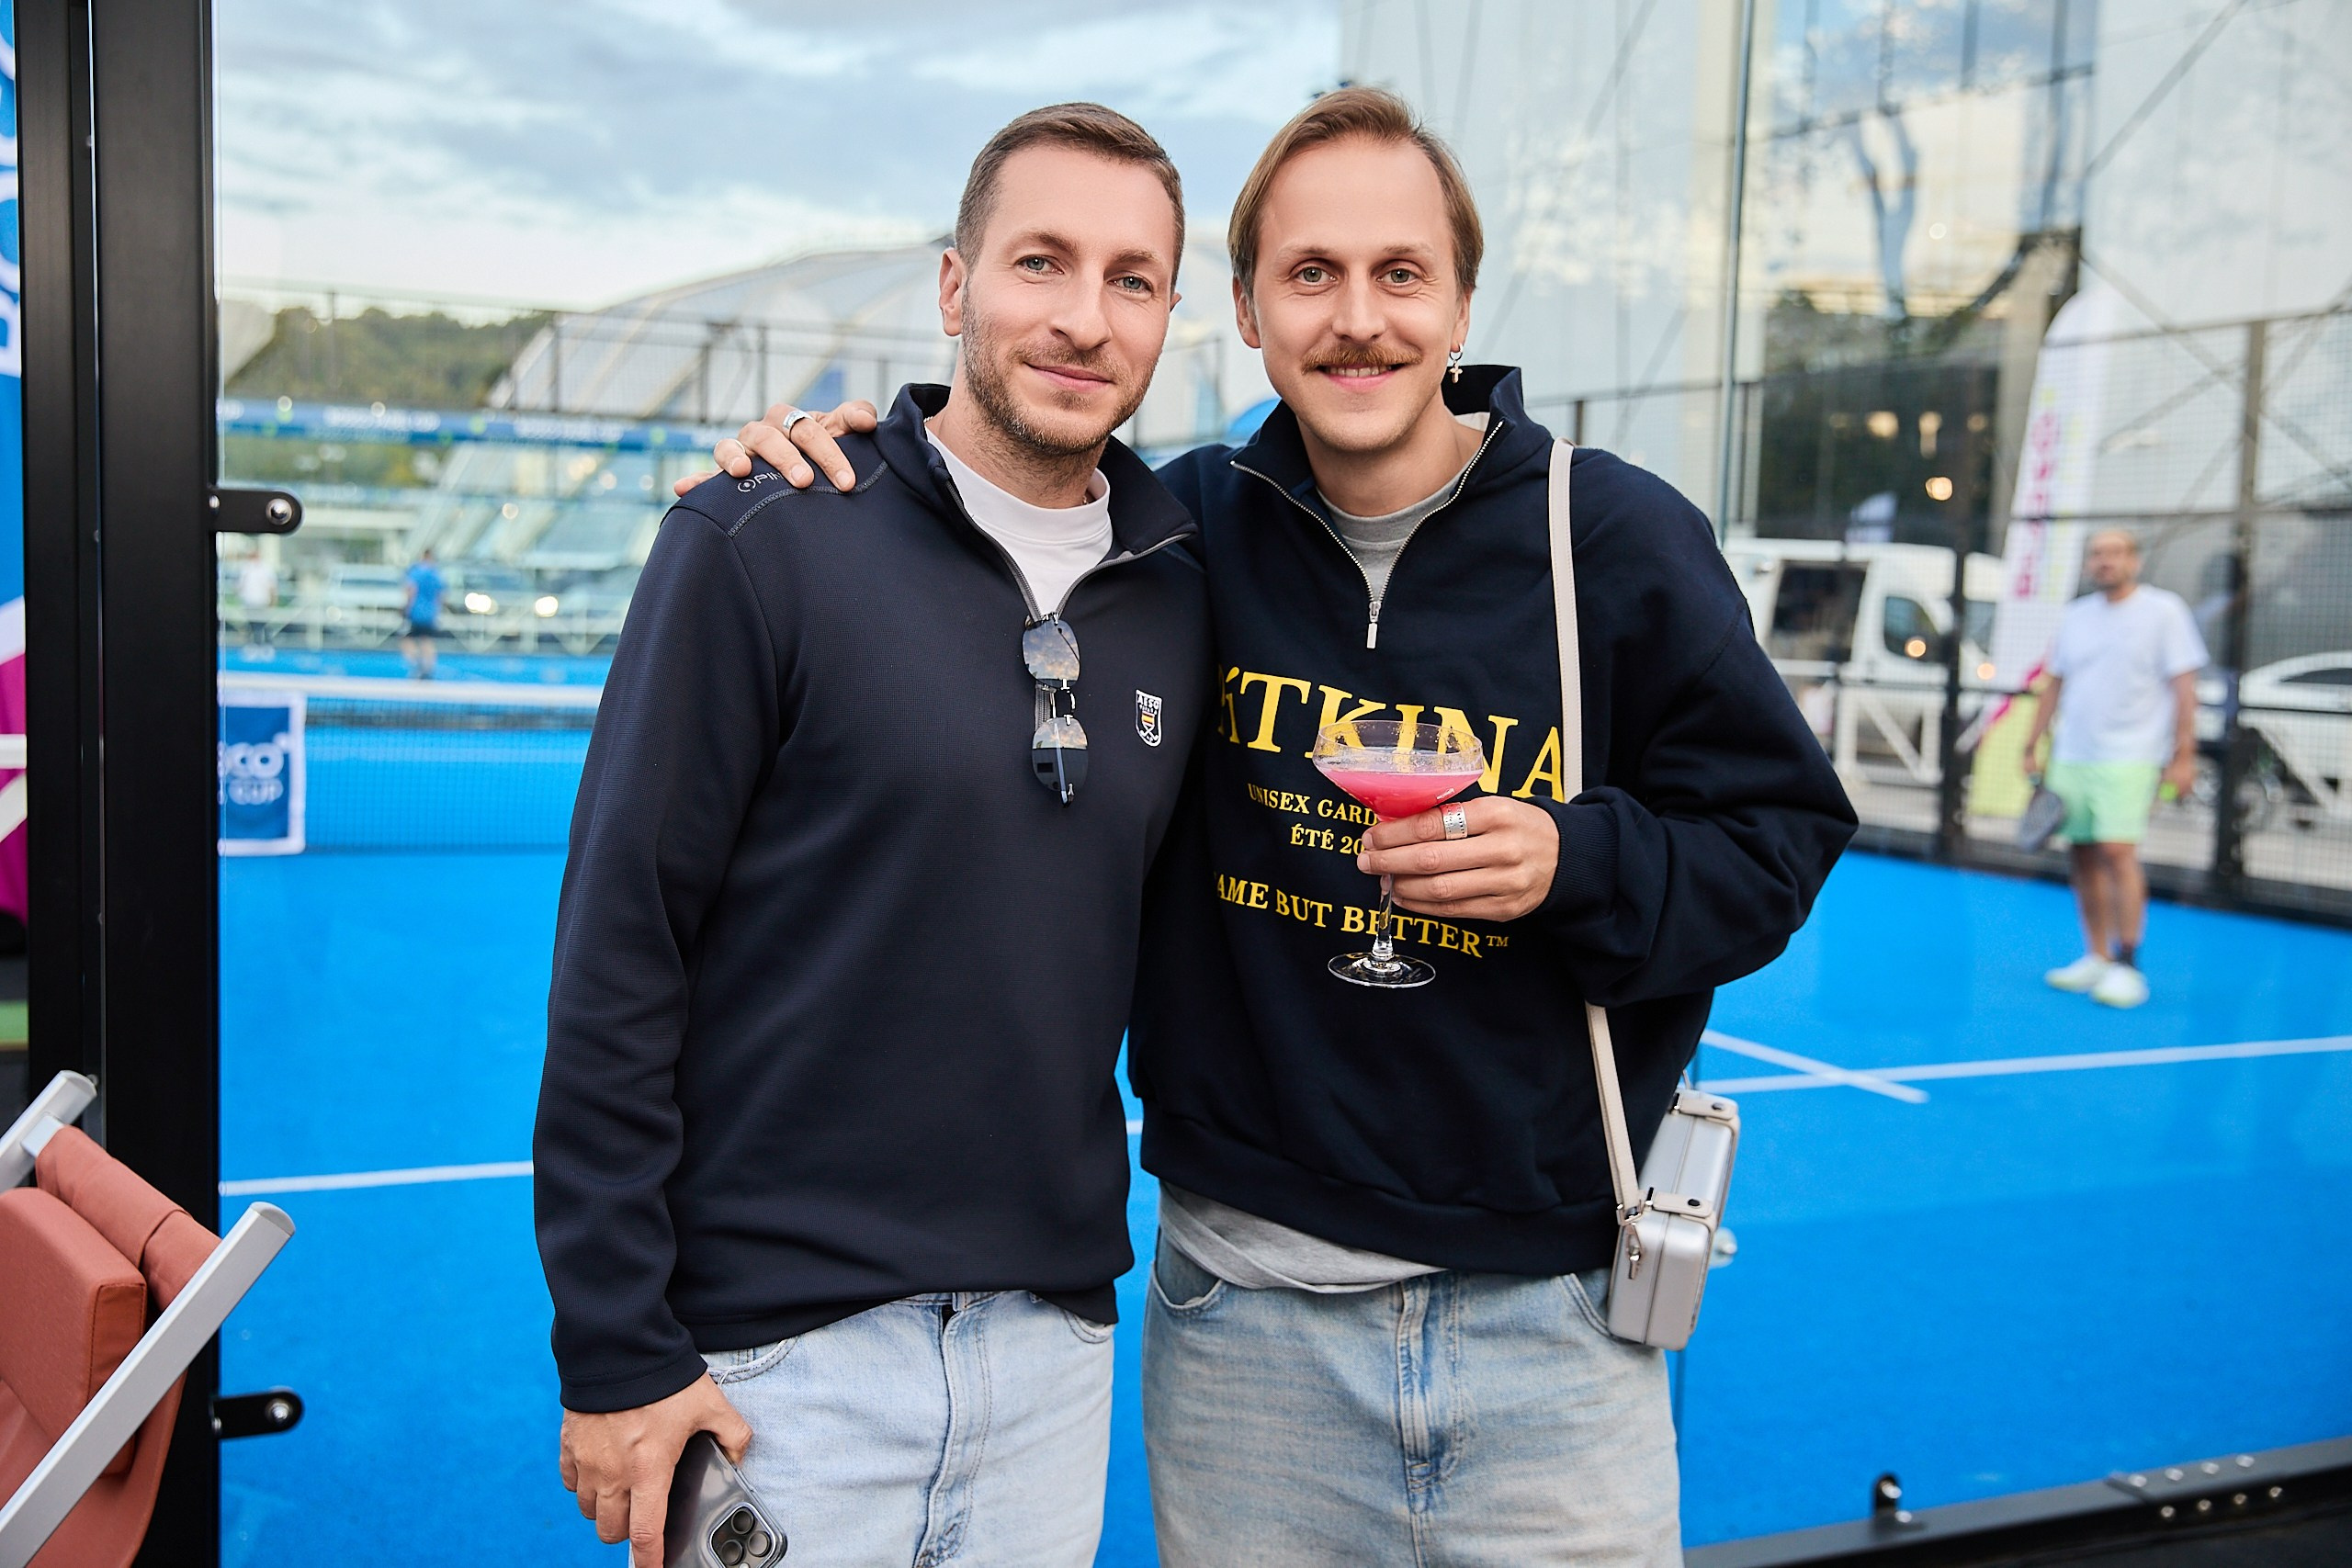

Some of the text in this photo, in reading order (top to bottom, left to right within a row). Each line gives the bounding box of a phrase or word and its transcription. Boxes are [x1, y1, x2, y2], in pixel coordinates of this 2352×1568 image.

[1247, 783, 1378, 827] UNISEX GARD
[1290, 823, 1365, 856] ÉTÉ 20
[1213, 872, 1269, 909] AME
[1275, 888, 1333, 928] BUT
